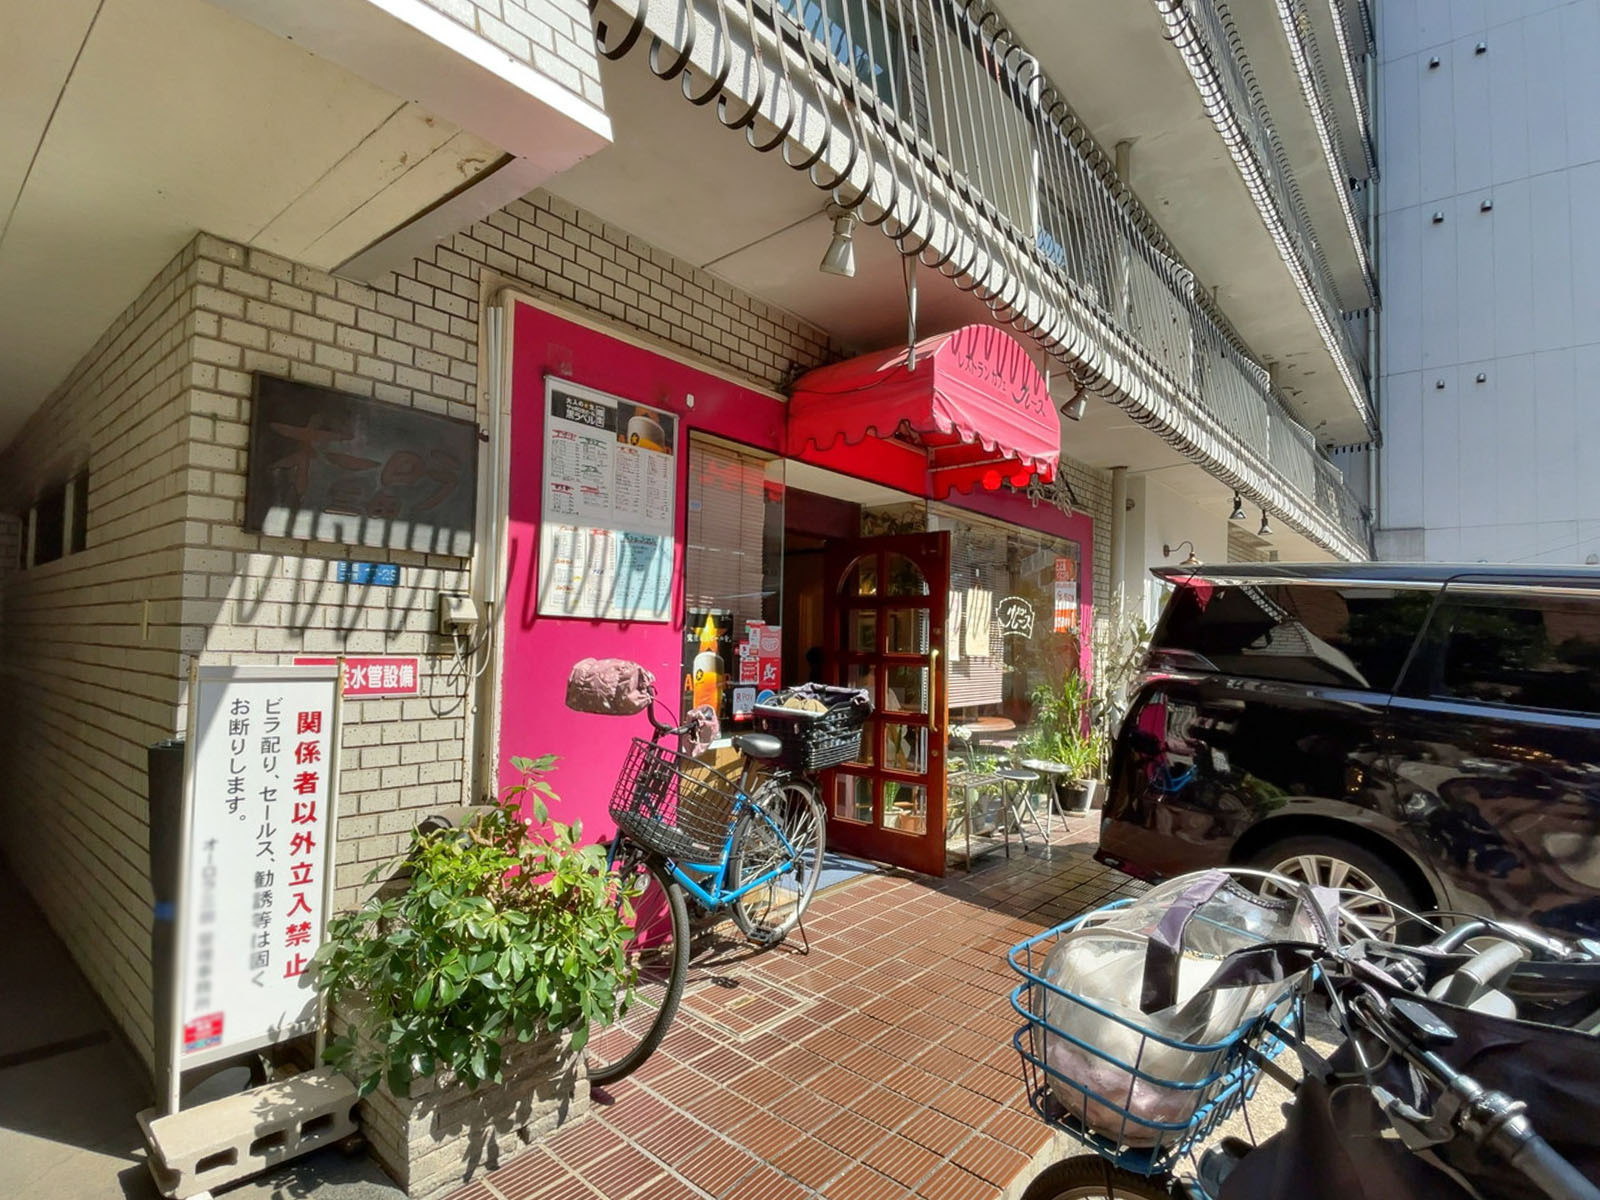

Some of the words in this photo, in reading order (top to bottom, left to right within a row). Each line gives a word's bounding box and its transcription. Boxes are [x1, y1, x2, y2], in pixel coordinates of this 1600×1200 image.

[225, 697, 251, 823] お断りします。
[283, 711, 323, 979] 関係者以外立入禁止
